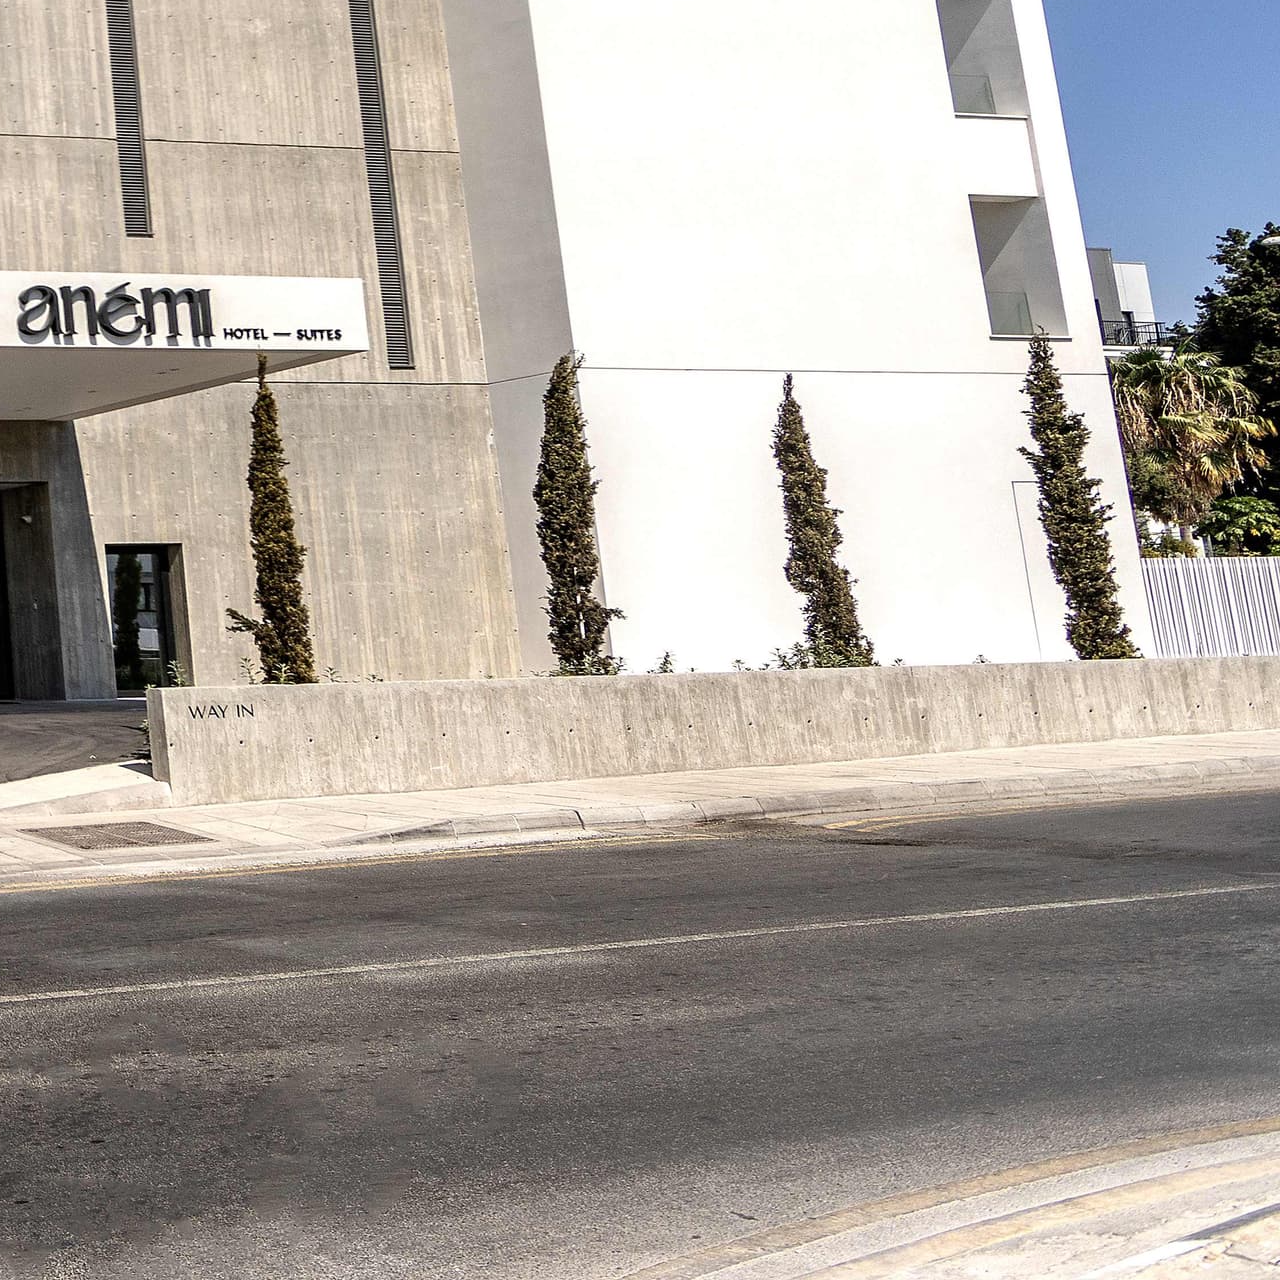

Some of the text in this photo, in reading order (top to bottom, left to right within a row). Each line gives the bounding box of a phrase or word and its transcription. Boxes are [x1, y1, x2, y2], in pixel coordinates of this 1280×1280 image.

[223, 327, 269, 341] HOTEL
[296, 329, 343, 342] SUITES
[188, 703, 255, 719] WAY IN
